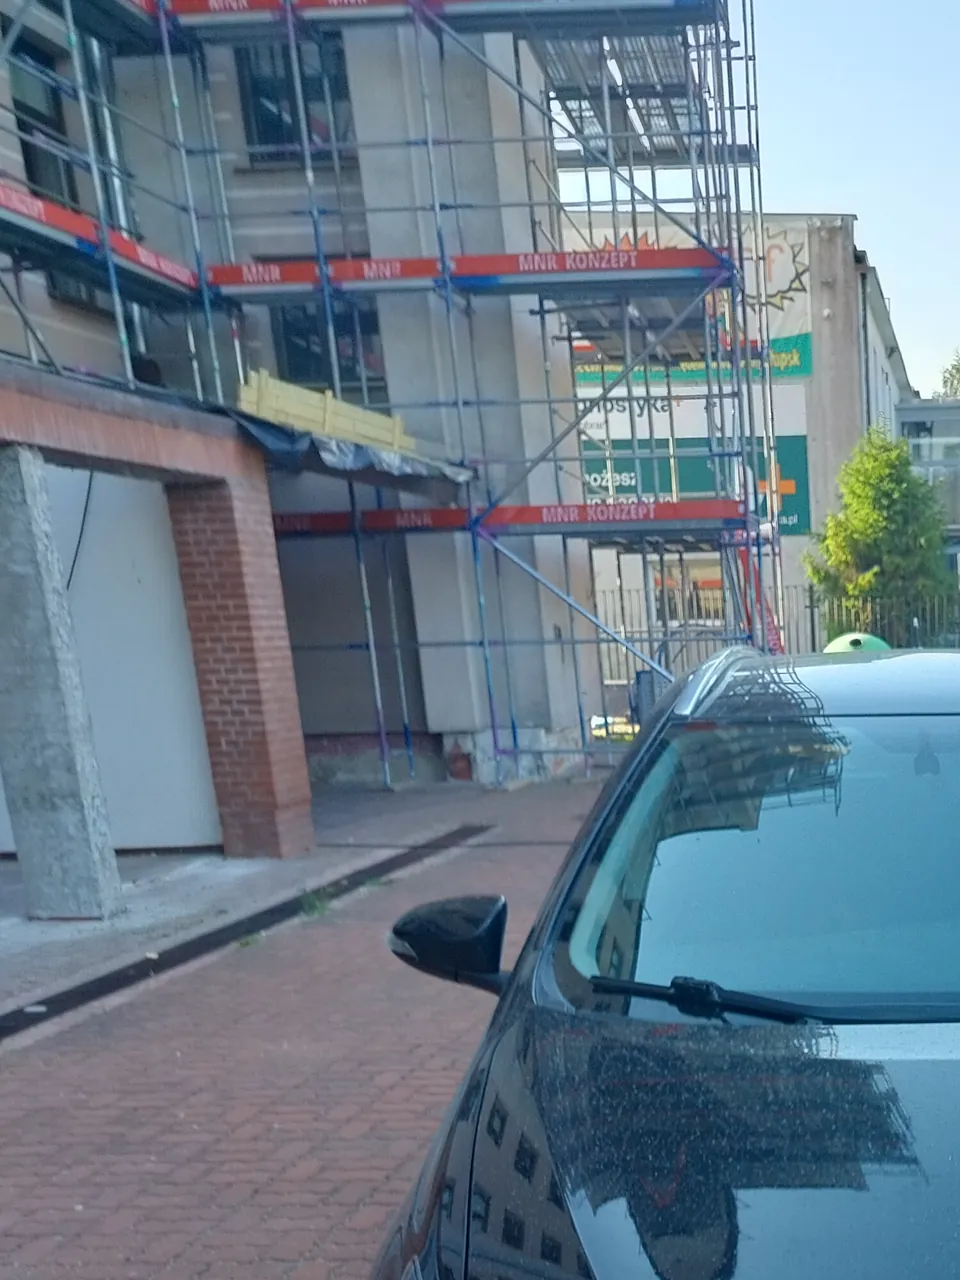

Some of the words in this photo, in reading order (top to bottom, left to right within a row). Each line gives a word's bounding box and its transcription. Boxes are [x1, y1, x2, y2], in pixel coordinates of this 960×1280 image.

[519, 252, 557, 271] MNR
[565, 251, 637, 269] KONZEPT
[542, 506, 579, 522] MNR
[586, 502, 656, 521] KONZEPT
